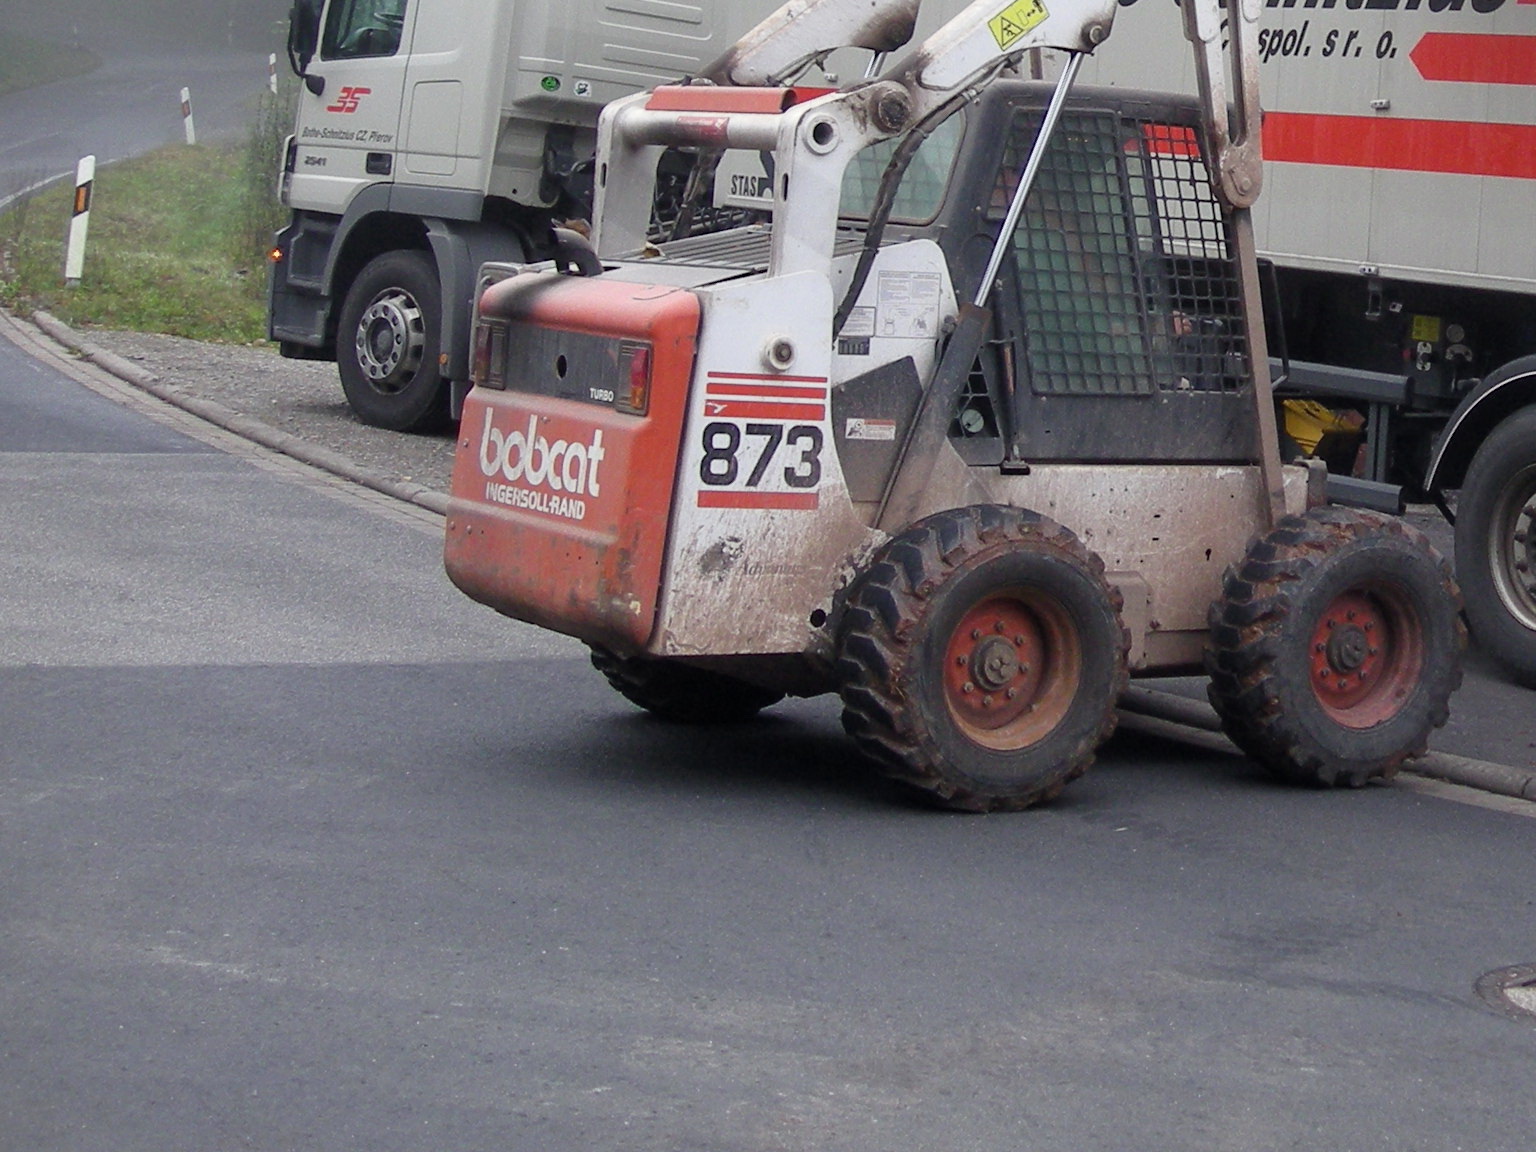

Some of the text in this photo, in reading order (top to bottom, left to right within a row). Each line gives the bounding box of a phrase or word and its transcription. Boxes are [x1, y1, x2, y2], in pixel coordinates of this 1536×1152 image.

[1258, 21, 1310, 64] spol.
[731, 174, 758, 197] STAS
[589, 387, 615, 402] TURBO
[480, 406, 605, 498] bobcat
[700, 422, 823, 489] 873
[485, 482, 586, 521] INGERSOLL-RAND
